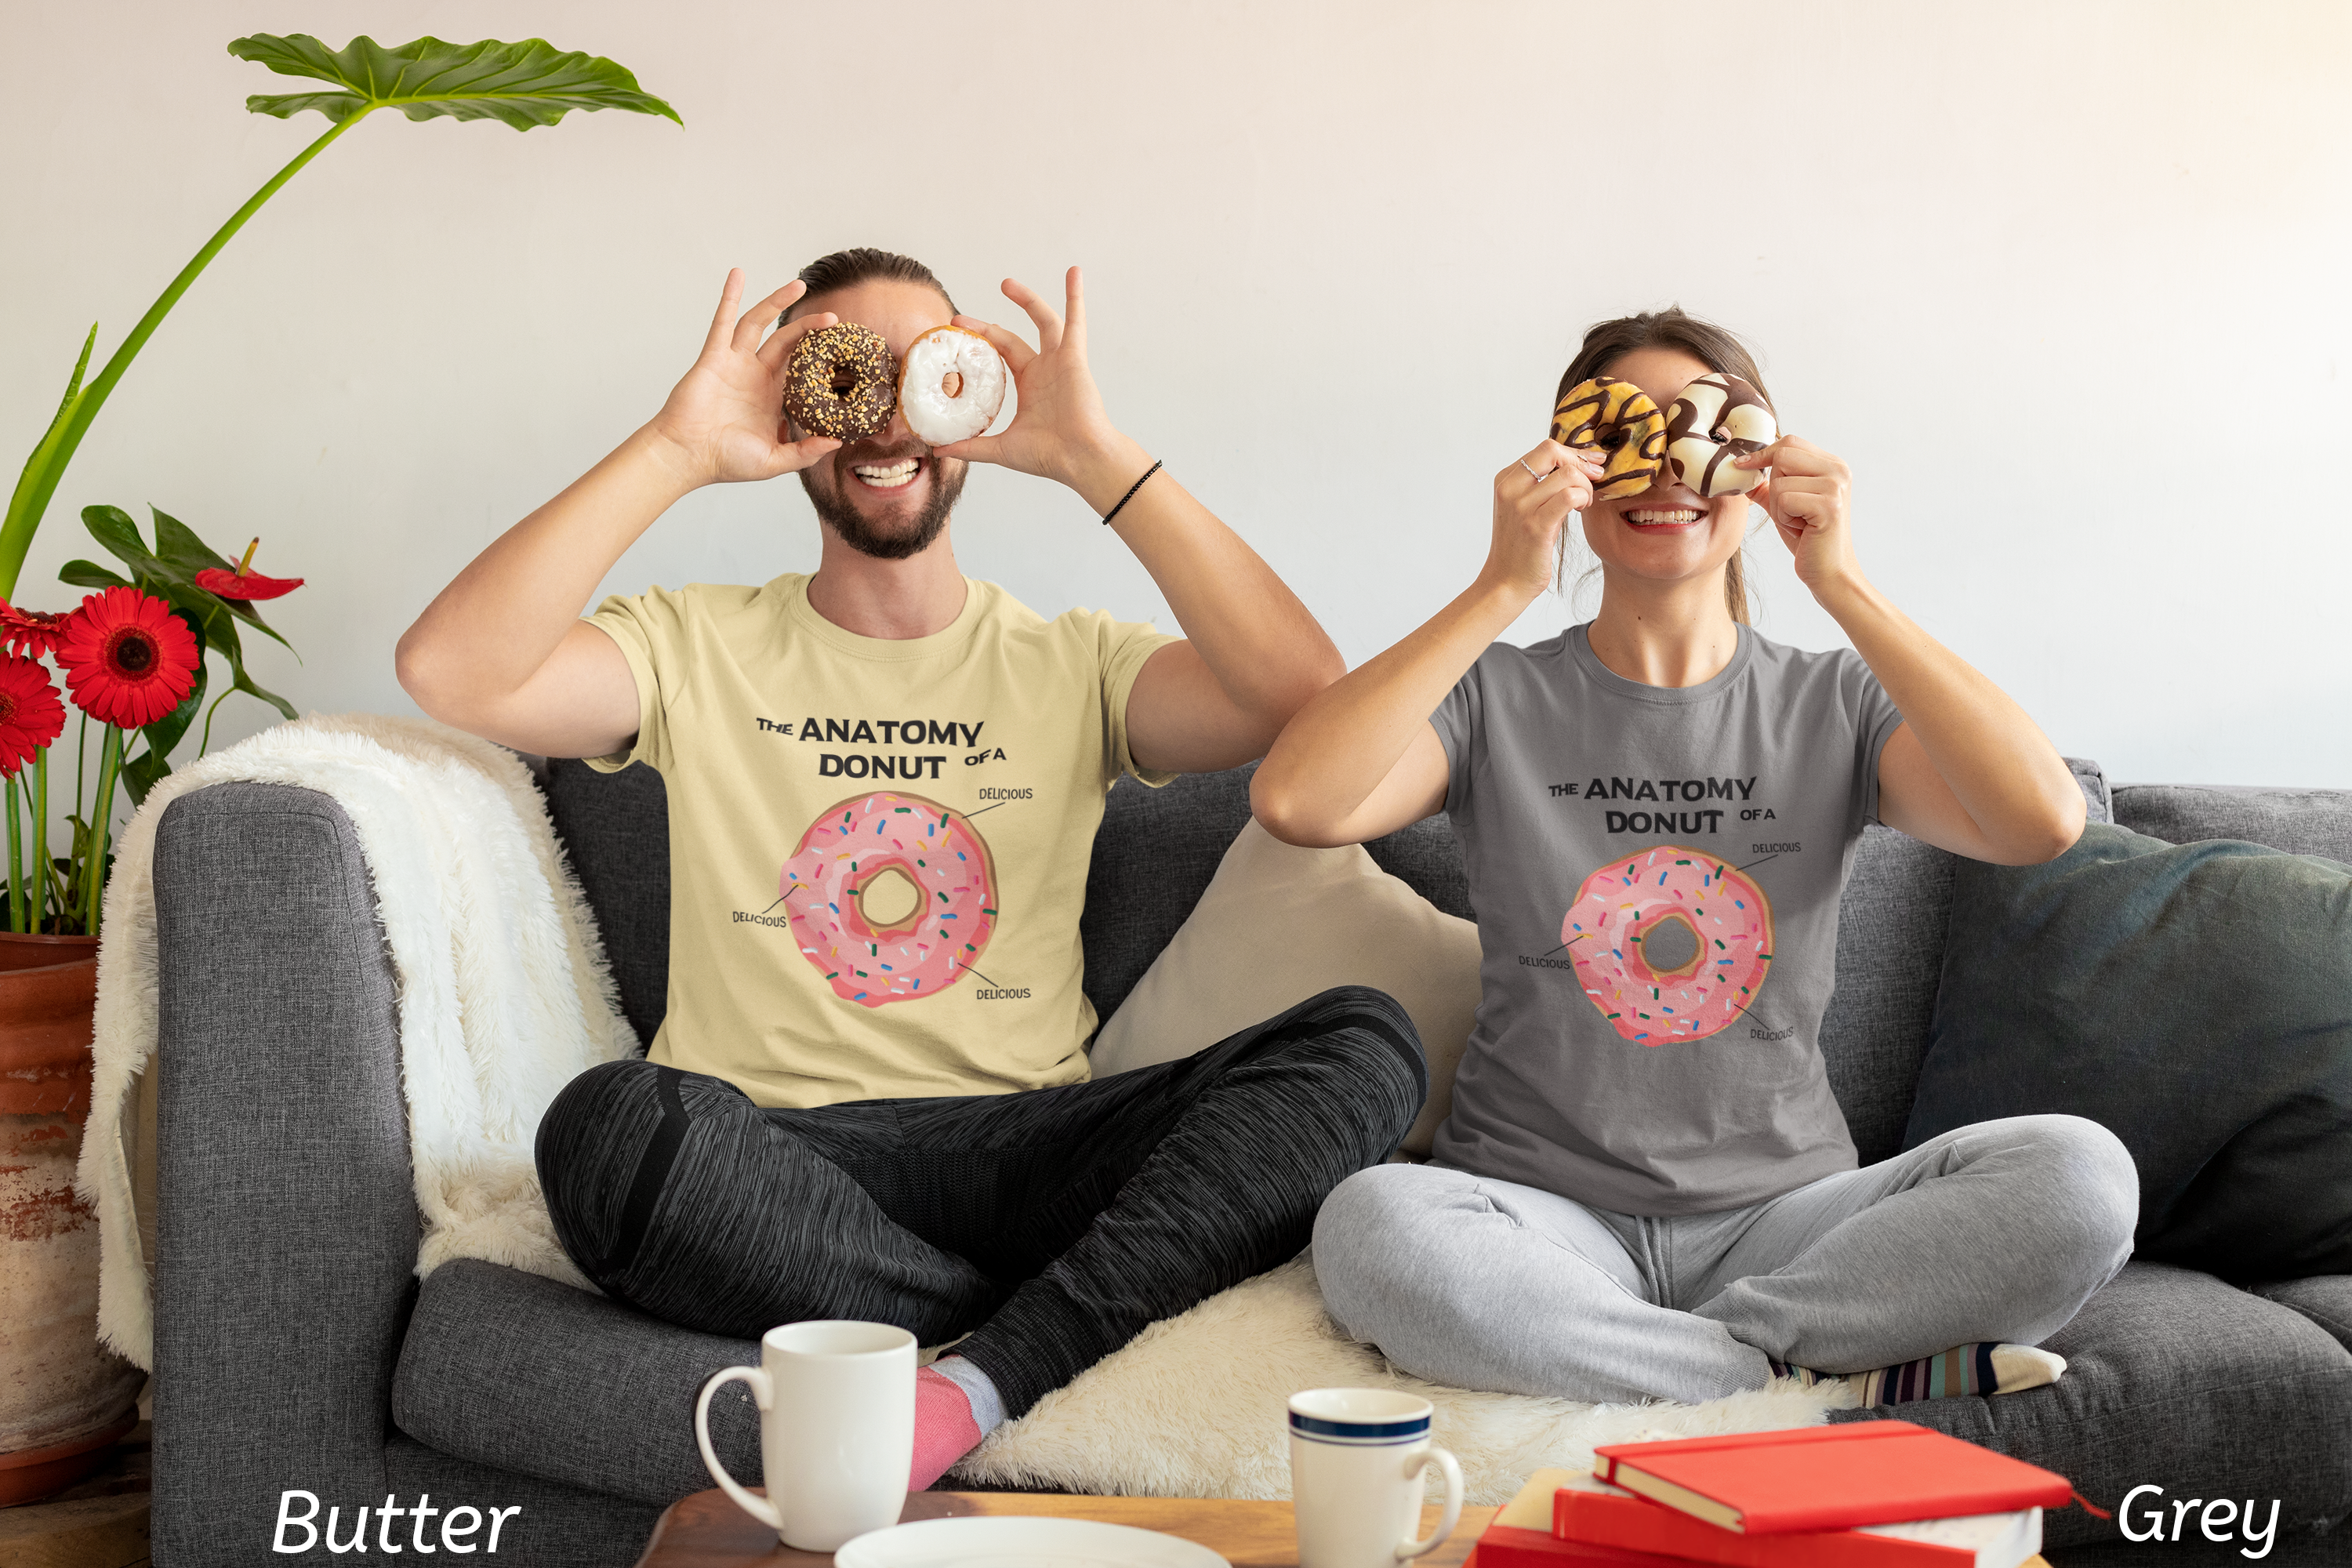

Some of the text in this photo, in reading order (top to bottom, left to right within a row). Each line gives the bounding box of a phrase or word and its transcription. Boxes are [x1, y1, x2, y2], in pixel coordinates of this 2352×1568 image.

[757, 717, 985, 748] THE ANATOMY
[818, 747, 1007, 780] DONUT OF A
[978, 787, 1033, 800] DELICIOUS
[1548, 776, 1758, 803] THE ANATOMY
[1605, 808, 1777, 834] DONUT OF A
[1752, 842, 1802, 854] DELICIOUS
[732, 911, 786, 928] DELICIOUS
[1519, 955, 1570, 970] DELICIOUS
[976, 988, 1031, 1000] DELICIOUS
[1750, 1026, 1794, 1042] DELICIOUS
